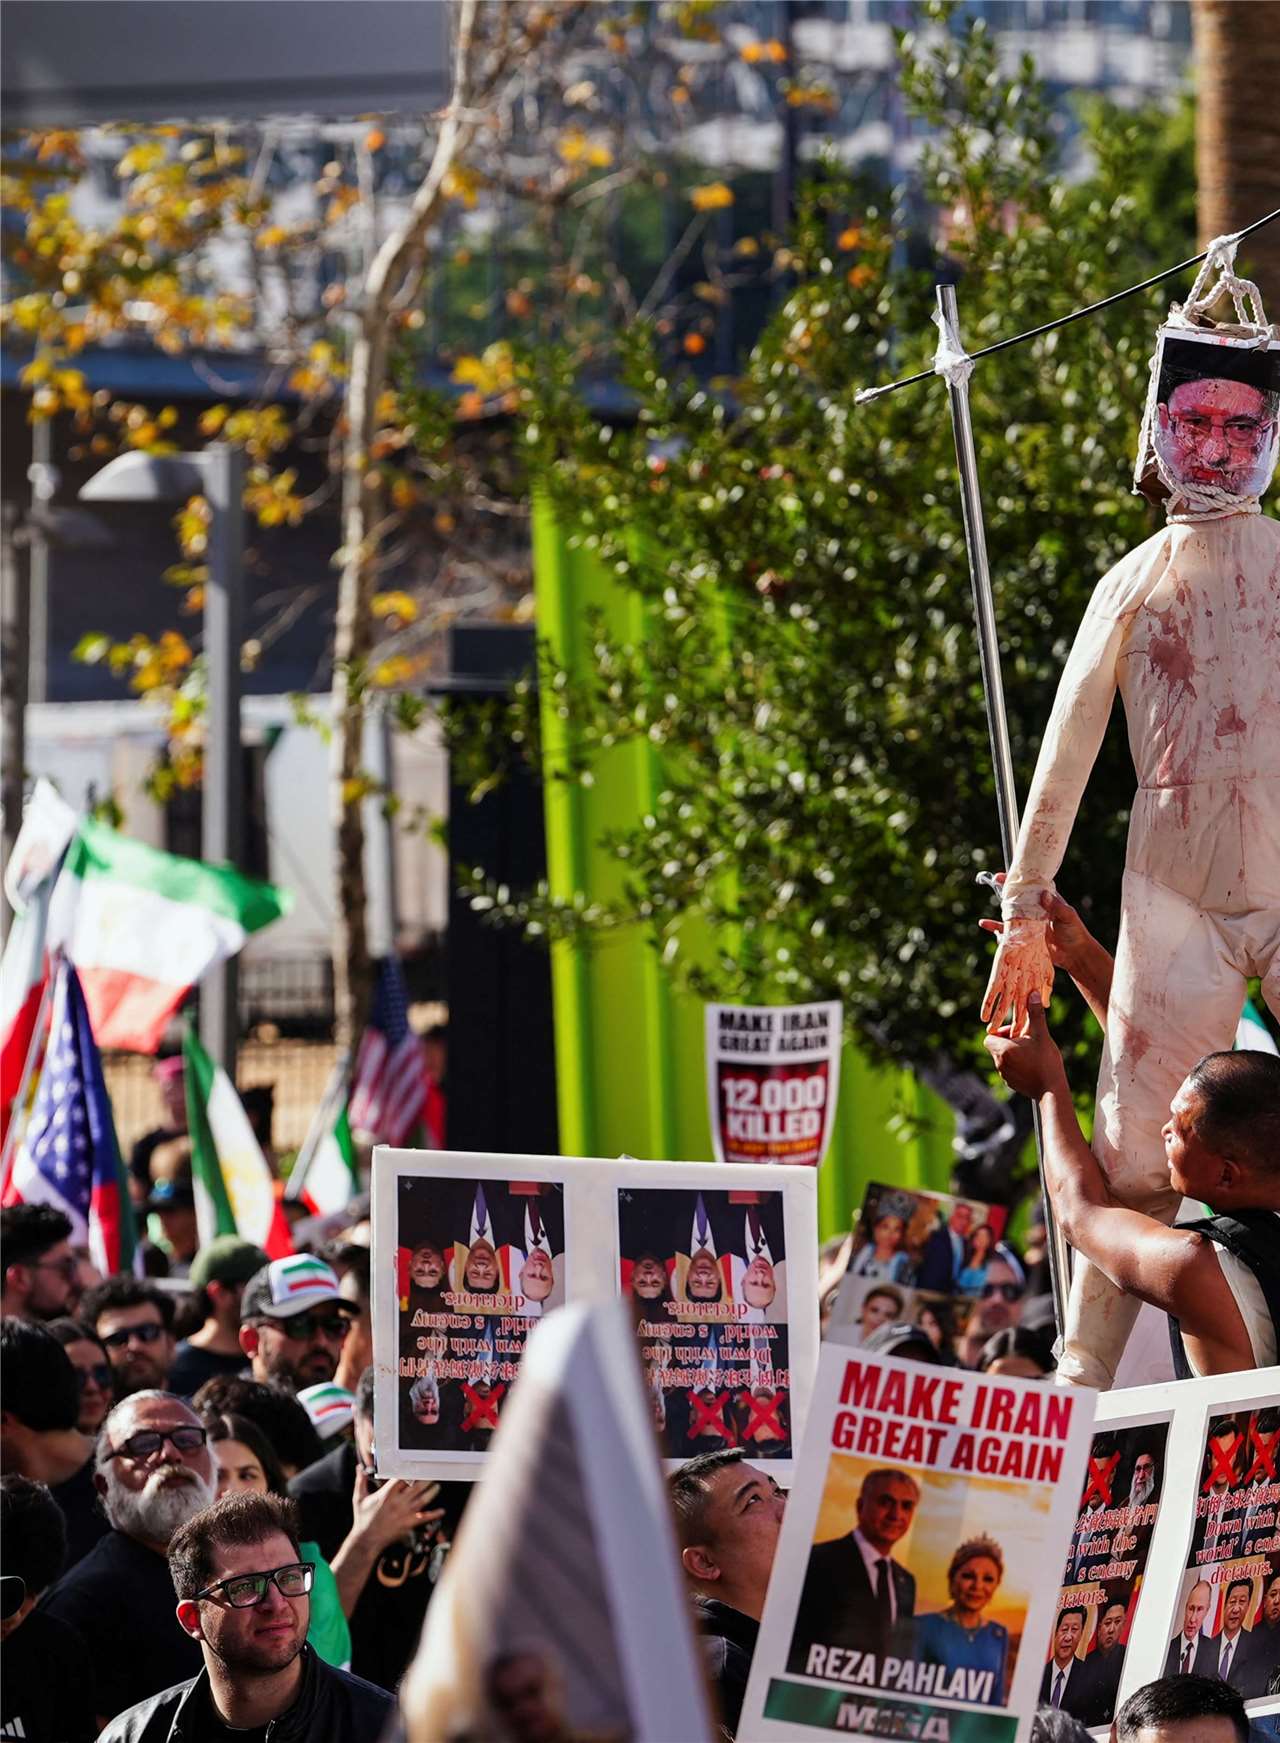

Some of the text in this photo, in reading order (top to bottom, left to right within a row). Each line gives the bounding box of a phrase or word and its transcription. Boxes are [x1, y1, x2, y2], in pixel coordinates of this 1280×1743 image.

[719, 1011, 828, 1031] MAKE IRAN
[720, 1034, 827, 1051] GREAT AGAIN
[722, 1075, 826, 1113] 12,000
[727, 1111, 820, 1142] KILLED
[440, 1291, 525, 1311] dictators.
[662, 1302, 748, 1319] dictators.
[410, 1308, 471, 1328] enemy
[496, 1316, 538, 1336] orld’
[638, 1319, 695, 1337] enemy
[416, 1336, 527, 1357] wn with the
[643, 1346, 772, 1365] Down with the
[838, 1360, 1073, 1440] MAKE IRAN
[832, 1412, 1064, 1483] GREAT AGAIN
[1204, 1519, 1242, 1539] Down
[1246, 1508, 1275, 1530] with
[1077, 1535, 1110, 1556] with
[1112, 1535, 1137, 1553] the
[1088, 1560, 1138, 1580] enemy
[1211, 1561, 1273, 1584] dictators.
[806, 1643, 994, 1702] REZA PAHLAVI
